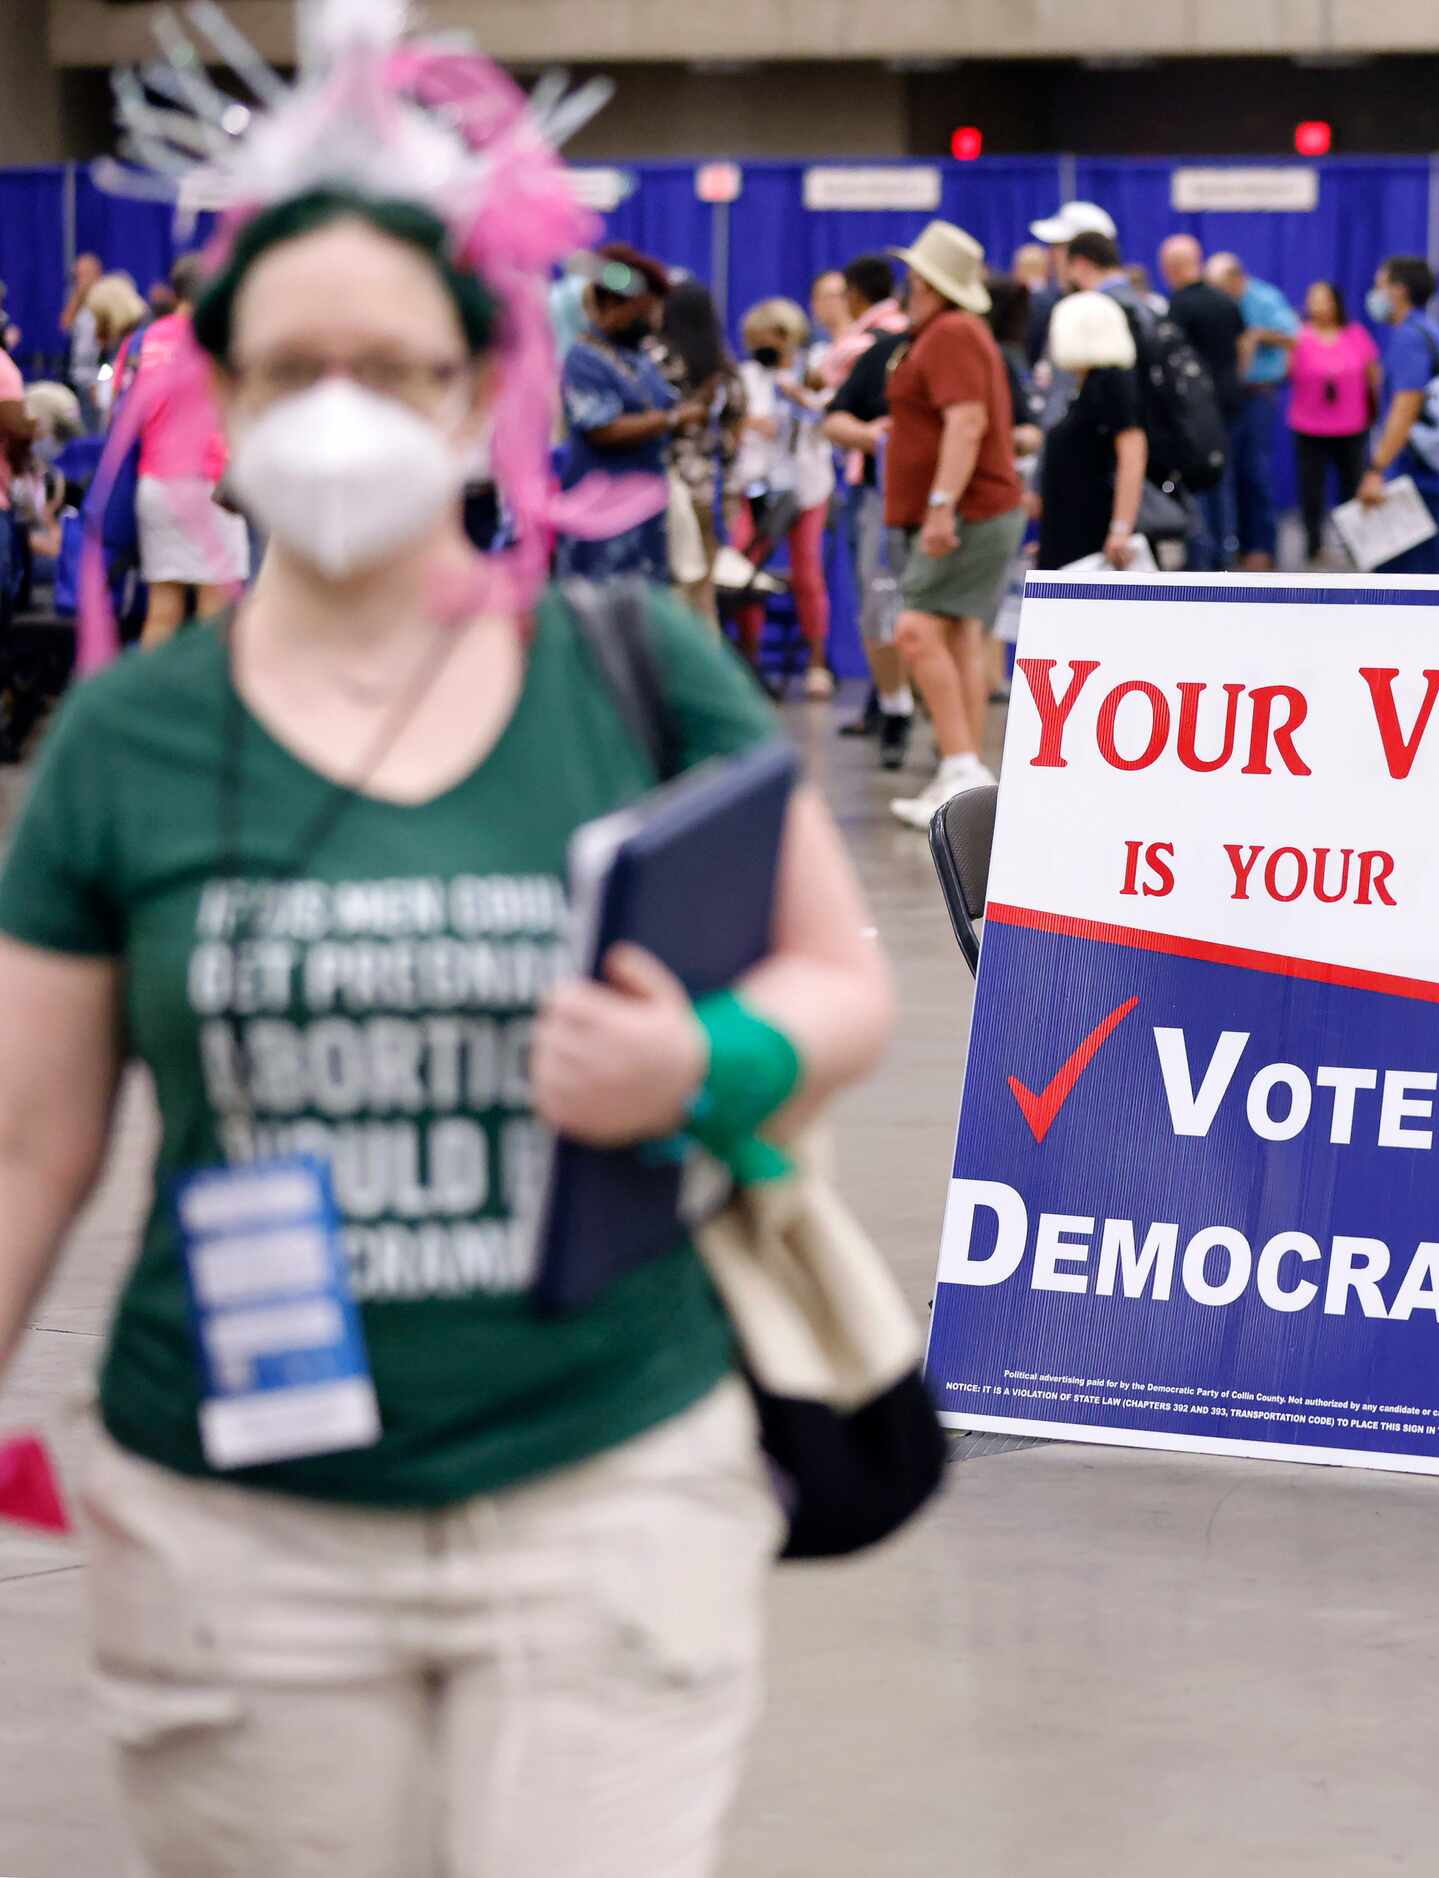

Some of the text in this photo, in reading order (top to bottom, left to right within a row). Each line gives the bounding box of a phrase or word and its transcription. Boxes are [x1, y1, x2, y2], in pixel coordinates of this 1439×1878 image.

[1018, 658, 1311, 777] YOUR
[1120, 840, 1175, 897] IS
[1223, 844, 1397, 907] YOUR
[1153, 1026, 1438, 1150] VOTE
[946, 1382, 981, 1392] NOTICE:
[993, 1386, 1002, 1394] IS
[1003, 1388, 1010, 1397] A
[1012, 1388, 1058, 1400] VIOLATION
[1060, 1392, 1072, 1400] OF
[1074, 1394, 1100, 1404] STATE
[1102, 1397, 1121, 1406] LAW
[1122, 1399, 1171, 1410] (CHAPTERS
[1173, 1404, 1189, 1412] 392
[1190, 1406, 1209, 1414] AND
[1210, 1407, 1228, 1417] 393,
[1230, 1409, 1306, 1423] TRANSPORTATION
[1308, 1416, 1335, 1427] CODE)
[1337, 1418, 1349, 1426] TO
[1350, 1420, 1378, 1429] PLACE
[1380, 1422, 1400, 1431] THIS
[1402, 1424, 1424, 1433] SIGN
[1426, 1426, 1435, 1434] IN
[1004, 1370, 1037, 1381] Political
[1039, 1373, 1085, 1387] advertising
[1086, 1377, 1105, 1389] paid
[1106, 1379, 1118, 1387] for
[1119, 1380, 1130, 1390] by
[1132, 1382, 1145, 1390] the
[1147, 1383, 1195, 1394] Democratic
[1196, 1388, 1219, 1398] Party
[1231, 1391, 1255, 1400] Collin
[1257, 1393, 1287, 1404] County.
[1288, 1396, 1303, 1404] Not
[1304, 1399, 1348, 1408] authorized
[1350, 1401, 1361, 1411] by
[1362, 1404, 1377, 1412] any
[1379, 1405, 1420, 1414] candidate
